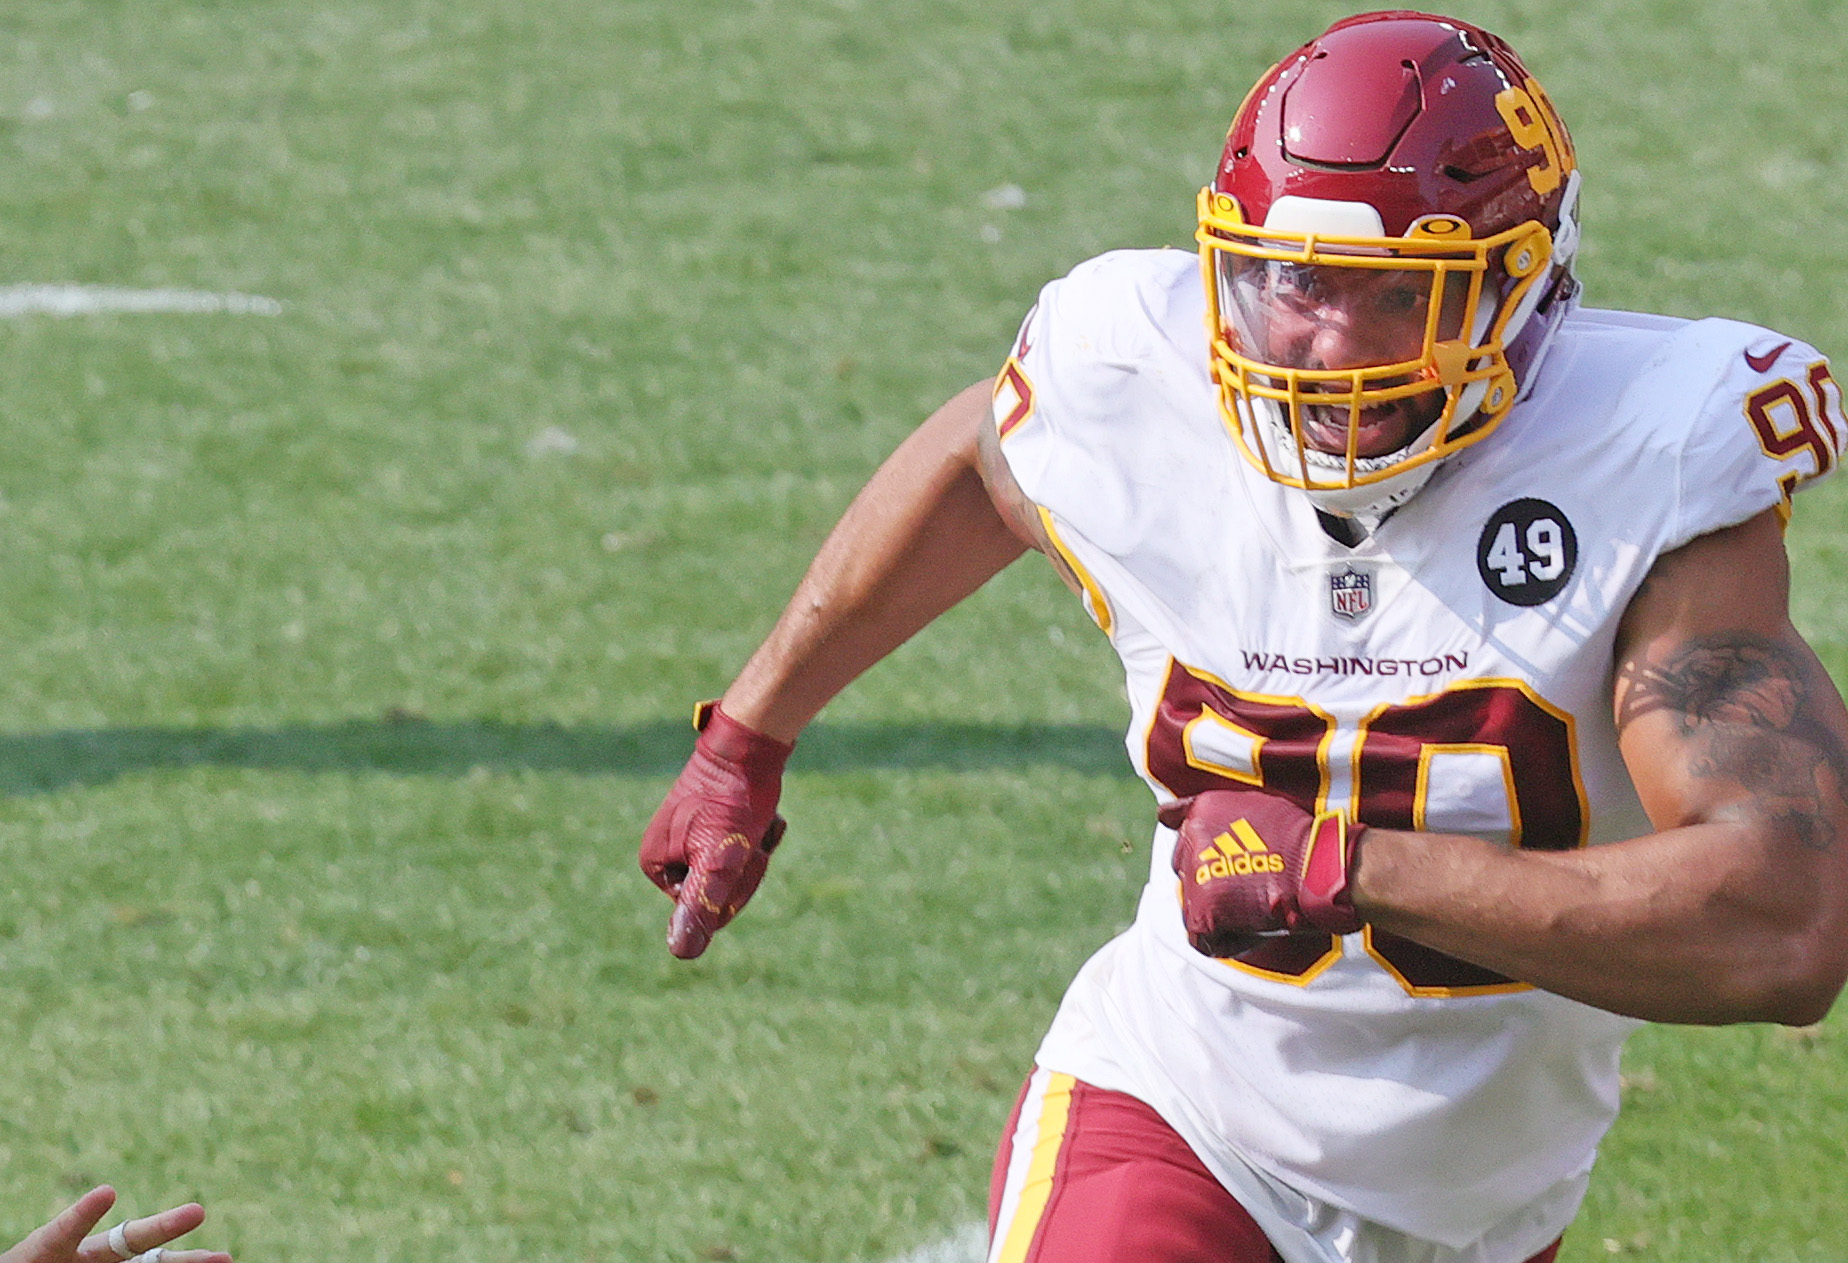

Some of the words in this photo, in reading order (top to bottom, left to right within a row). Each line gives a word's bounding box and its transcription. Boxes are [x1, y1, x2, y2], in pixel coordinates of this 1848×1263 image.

[1486, 518, 1565, 586] 49
[1336, 589, 1368, 613] NFL
[1240, 649, 1469, 677] WASHINGTON
[1195, 851, 1286, 886] adidas
